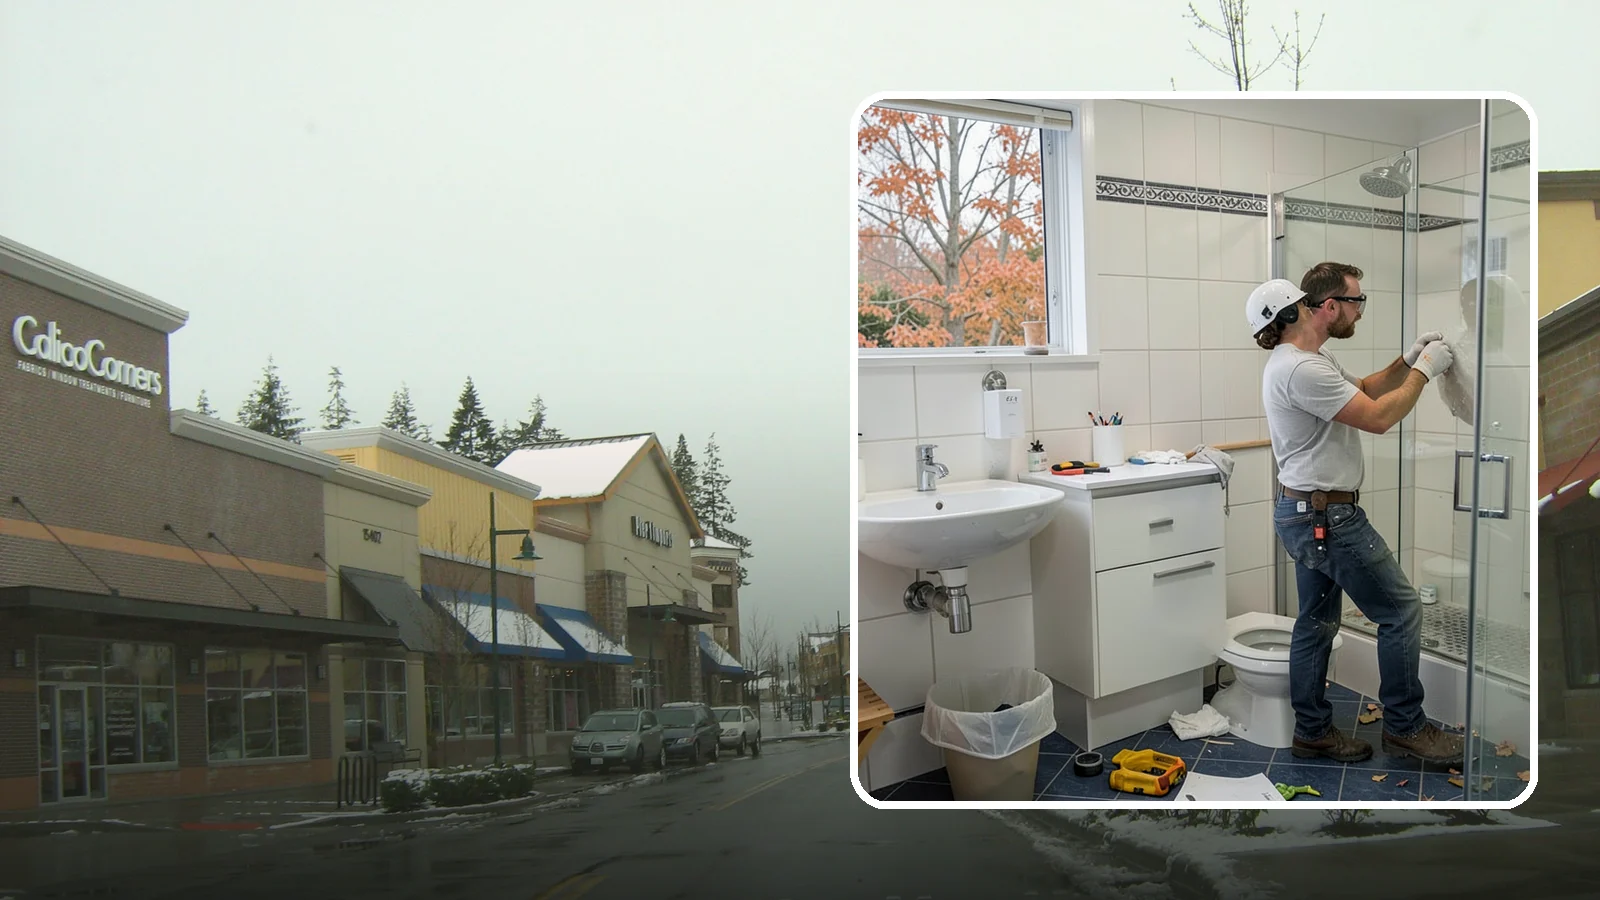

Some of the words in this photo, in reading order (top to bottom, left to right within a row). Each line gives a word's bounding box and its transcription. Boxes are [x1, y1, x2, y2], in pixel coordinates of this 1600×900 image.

[16, 360, 47, 377] FABRICS
[50, 370, 78, 387] WINDOW
[78, 378, 116, 398] TREATMENTS
[120, 391, 151, 409] FURNITURE
